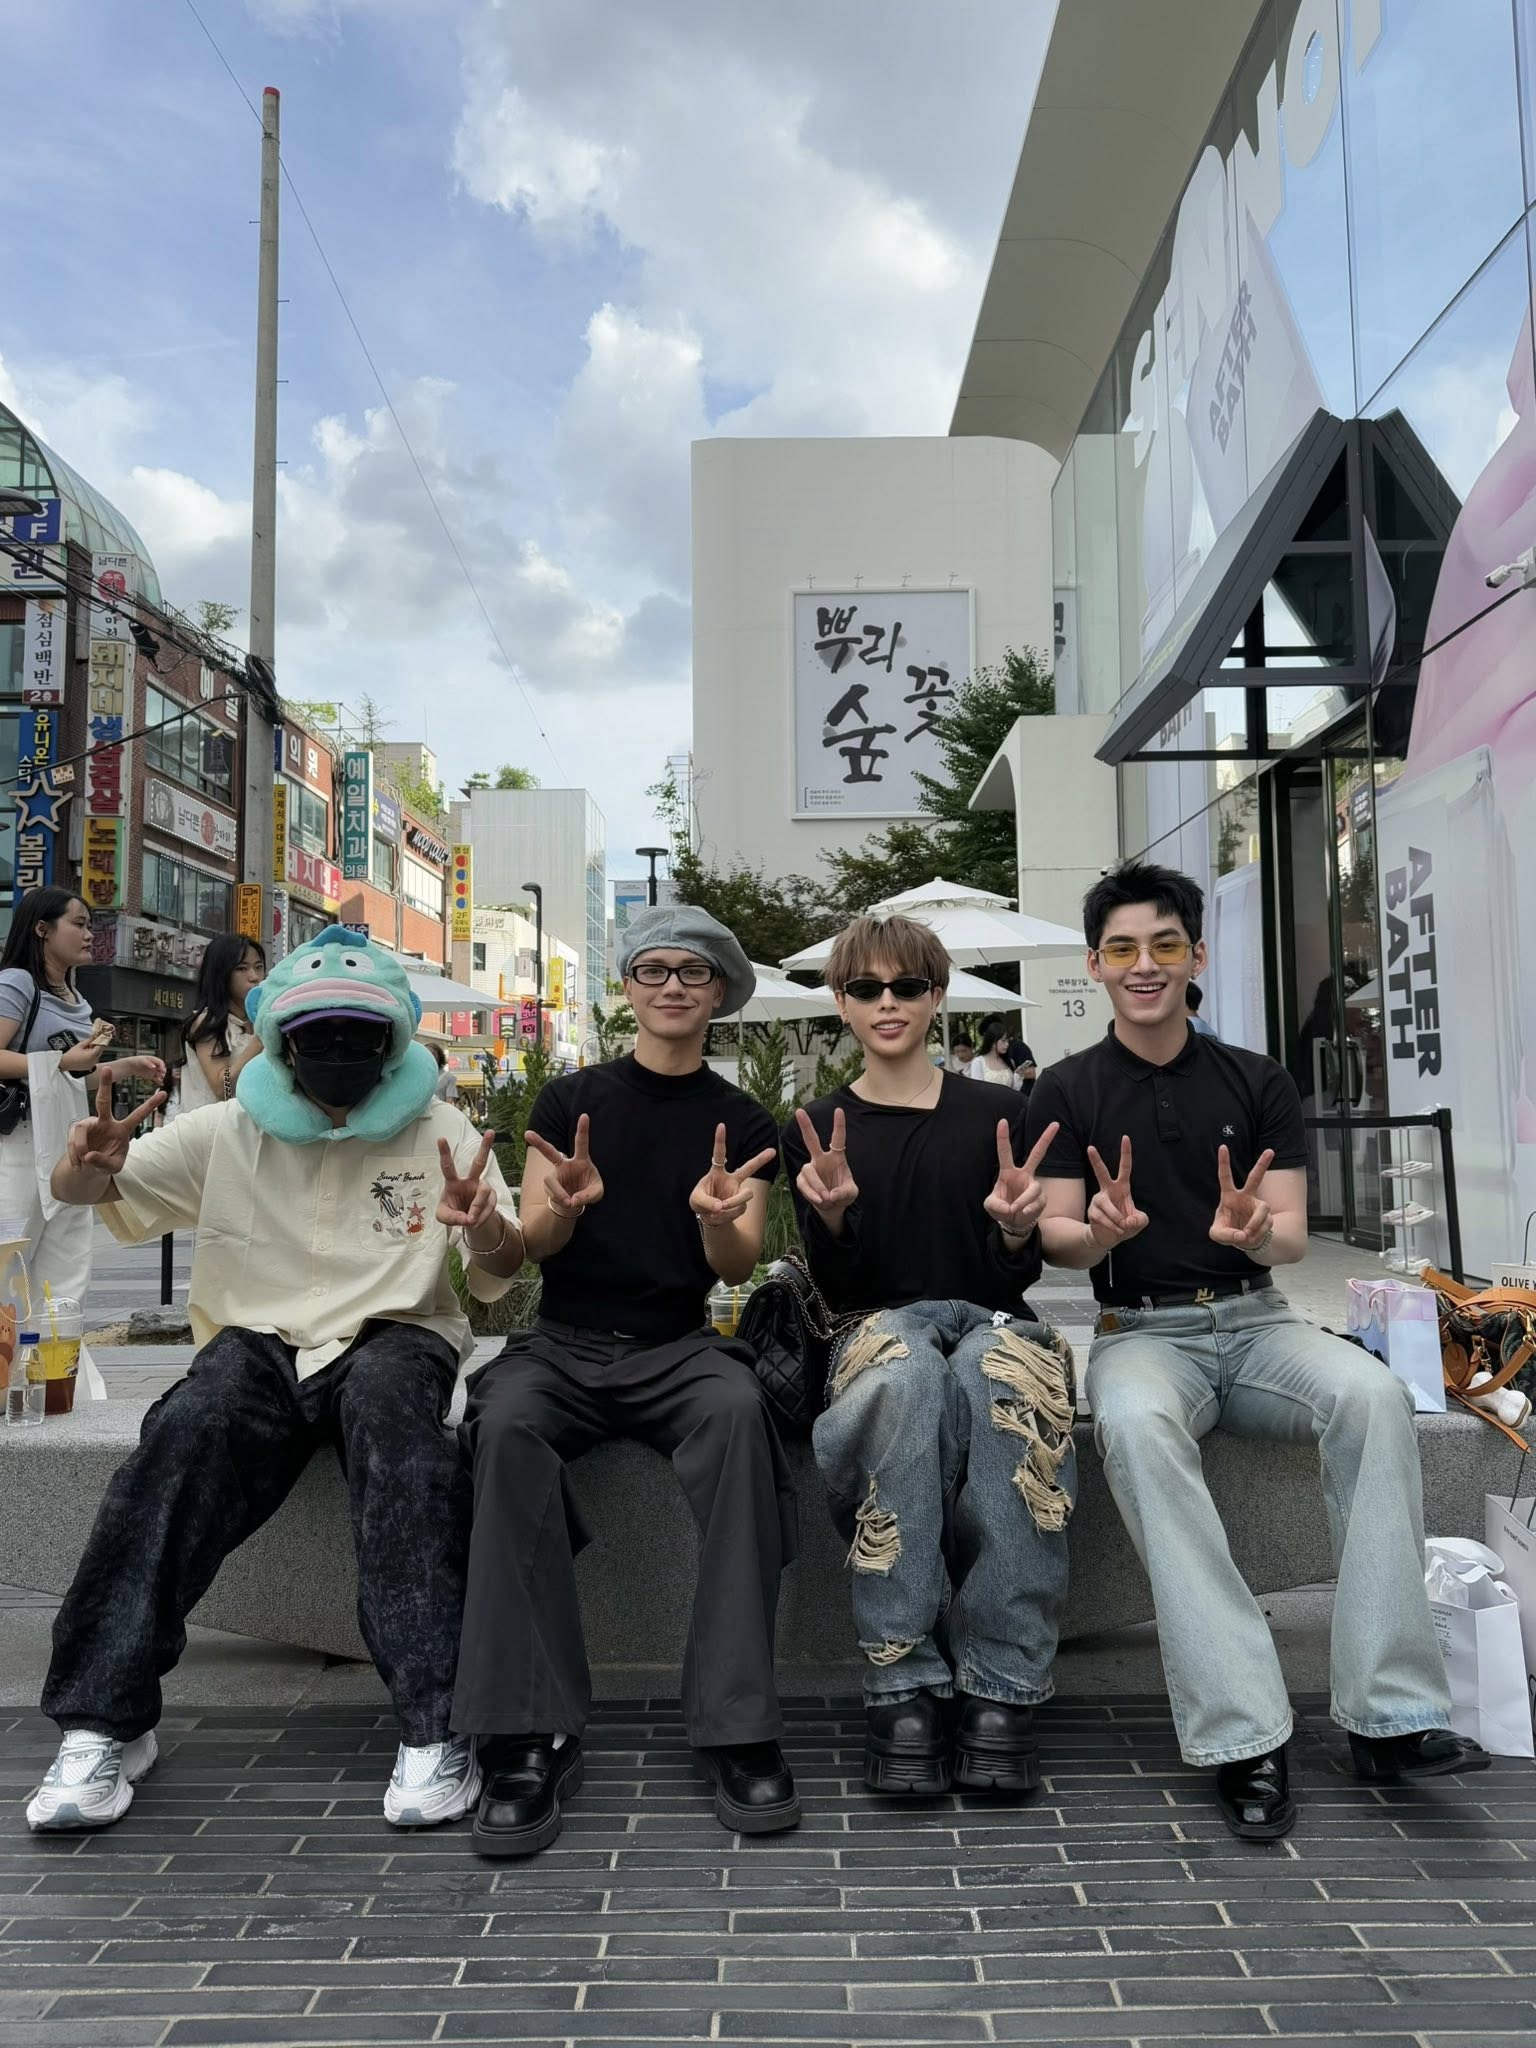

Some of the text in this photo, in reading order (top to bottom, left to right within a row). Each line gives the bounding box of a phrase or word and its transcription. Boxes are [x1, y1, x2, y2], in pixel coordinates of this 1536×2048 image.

[1209, 279, 1253, 443] AFTER
[1217, 311, 1258, 456] BATH
[33, 608, 54, 686] 점심백반
[815, 605, 902, 674] 뿌리
[821, 683, 897, 784] 숲
[903, 664, 959, 744] 꽃
[289, 734, 319, 780] 의원
[345, 757, 367, 859] 예일치과
[87, 819, 118, 905] 노래방
[345, 863, 368, 878] 의원
[456, 911, 469, 919] 2F
[1385, 866, 1415, 1060] BATH
[1408, 846, 1442, 1079] AFTER
[1062, 999, 1086, 1017] 13
[1501, 1276, 1530, 1290] OLIVE
